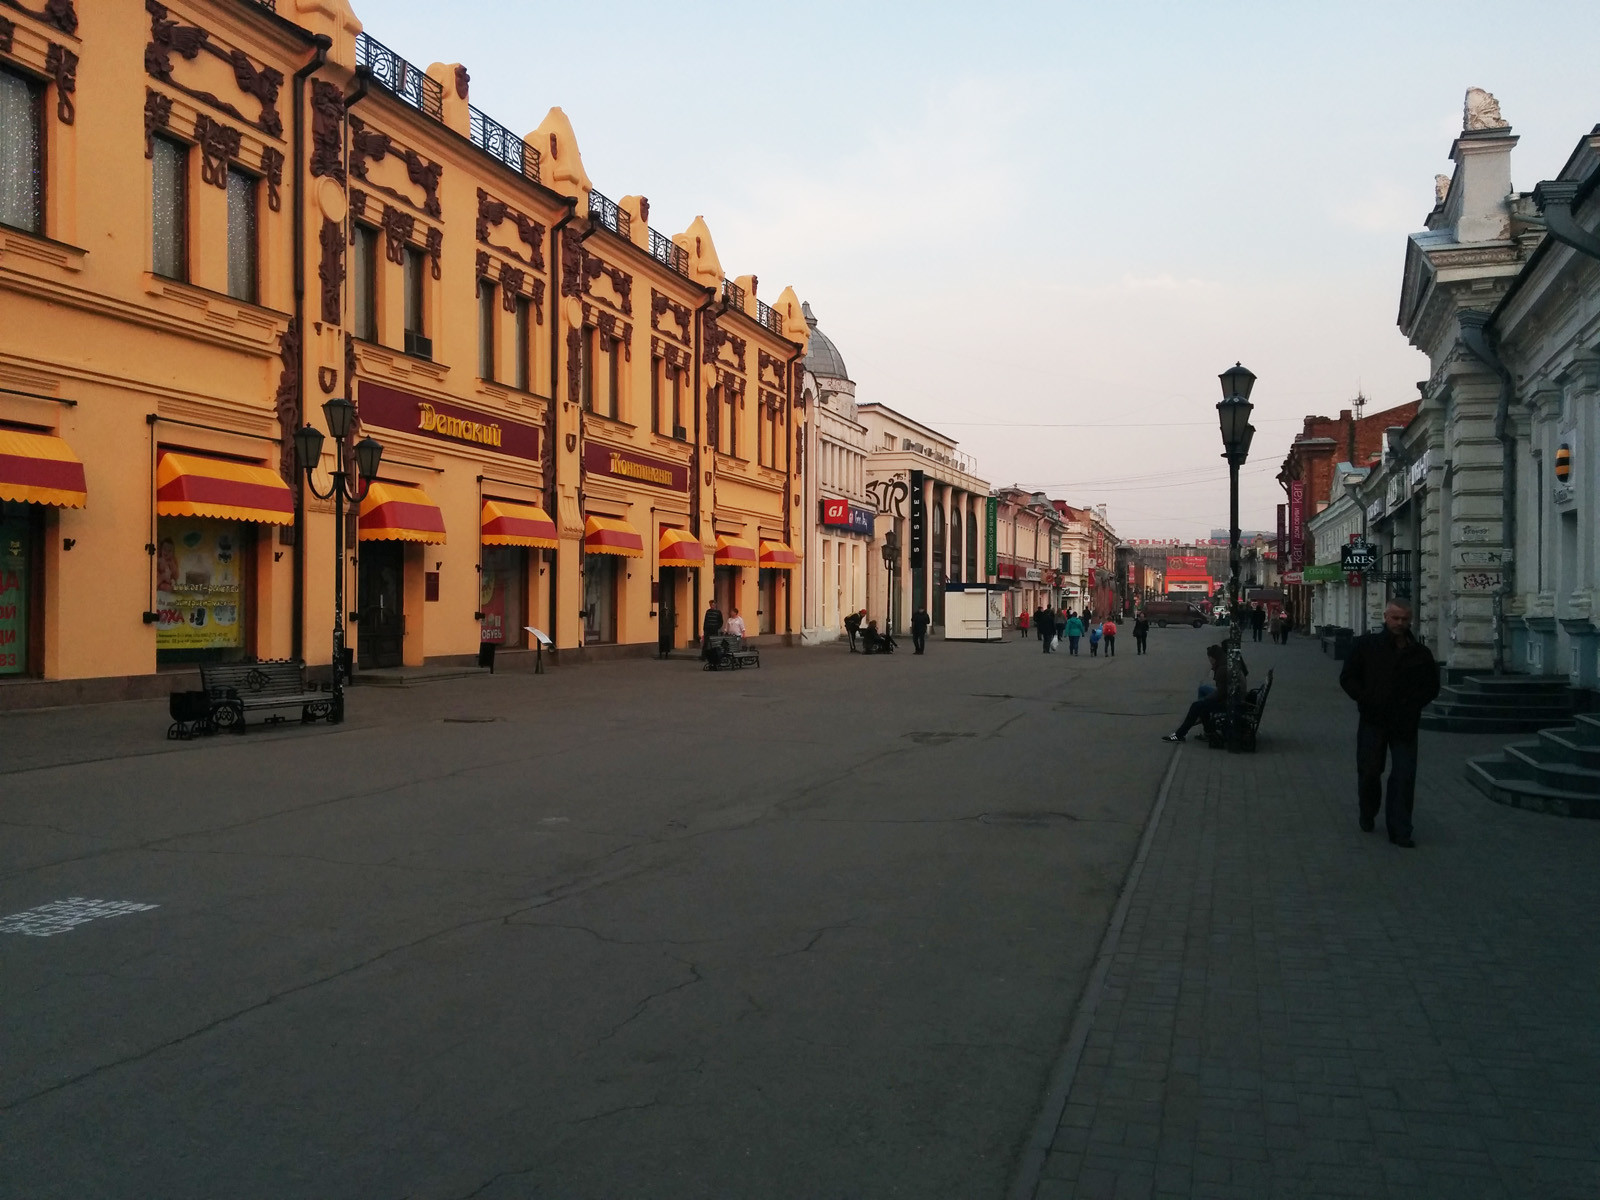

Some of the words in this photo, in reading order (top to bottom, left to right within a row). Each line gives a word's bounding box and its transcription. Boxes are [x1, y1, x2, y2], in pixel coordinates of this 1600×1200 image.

[418, 402, 502, 448] Детский
[828, 505, 844, 518] GJ
[1344, 555, 1375, 564] ARES
[481, 629, 503, 640] ОБУВЬ
